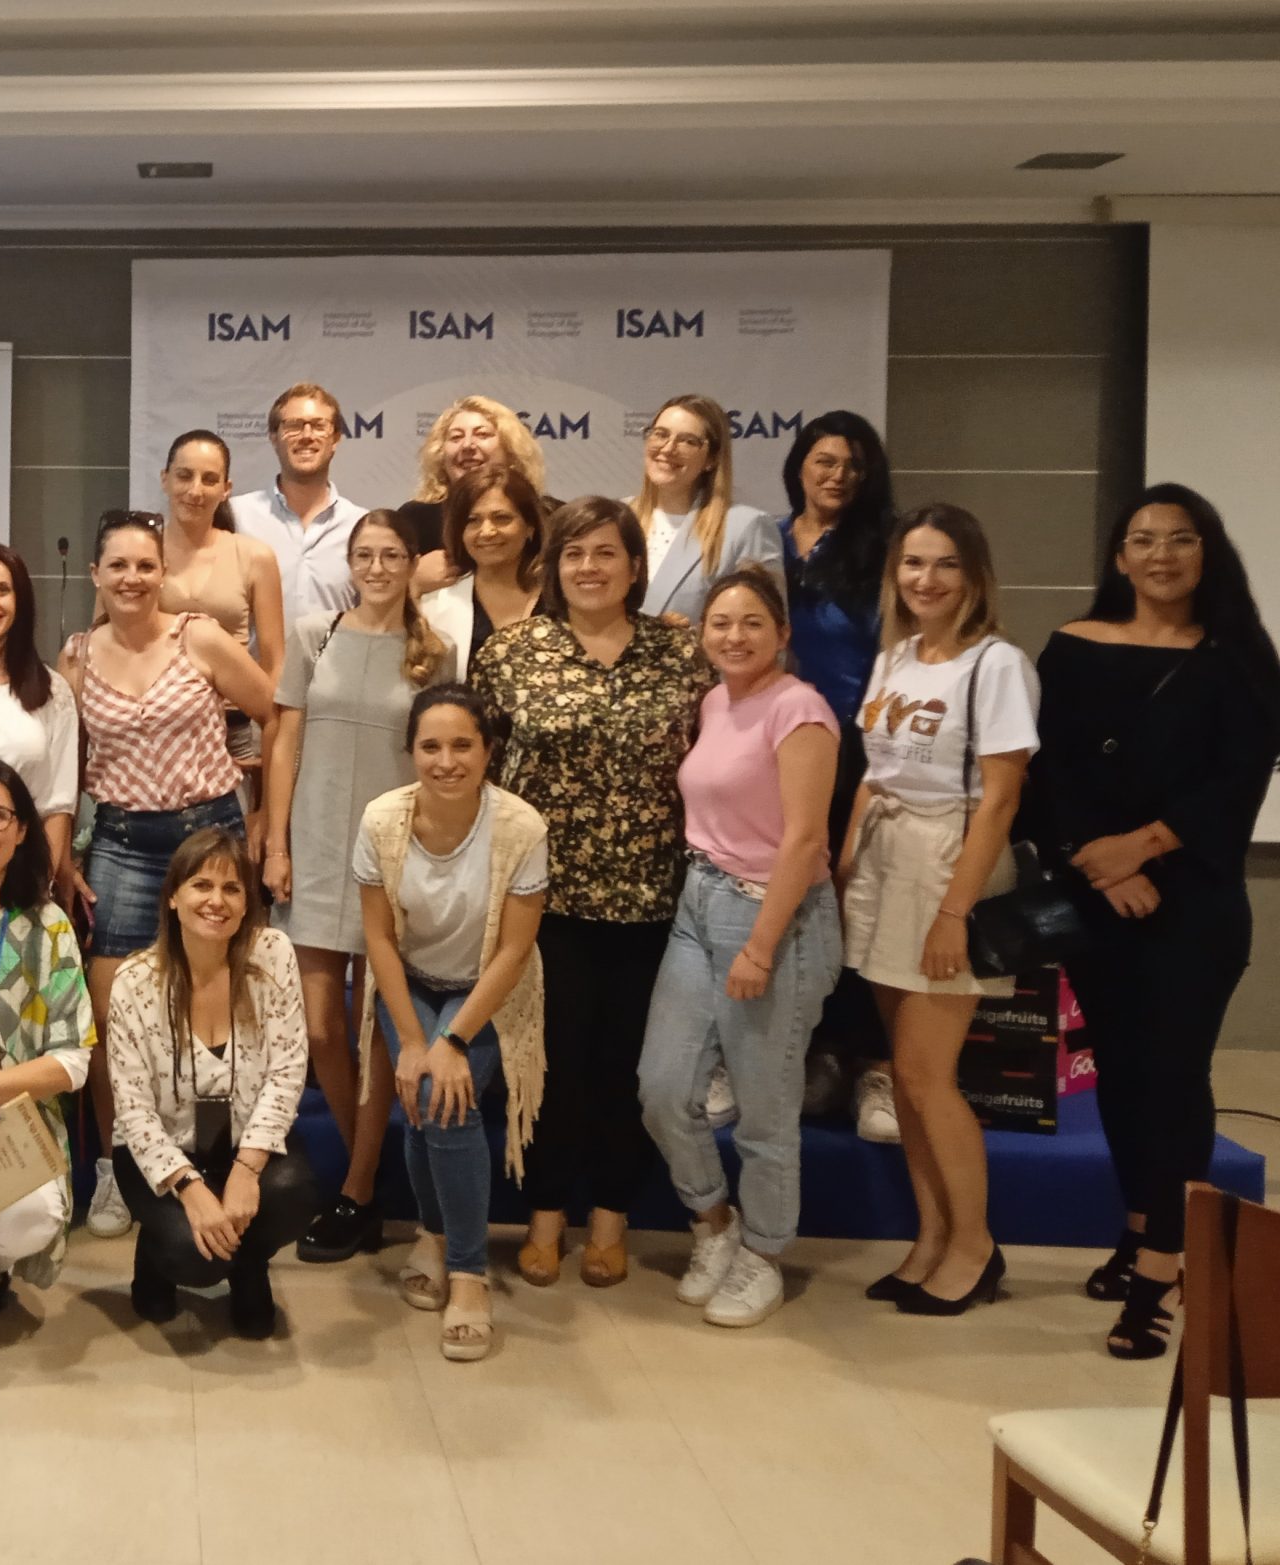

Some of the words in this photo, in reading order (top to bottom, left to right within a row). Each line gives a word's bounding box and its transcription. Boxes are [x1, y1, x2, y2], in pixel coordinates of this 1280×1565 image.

[208, 313, 291, 341] ISAM
[409, 310, 494, 340] ISAM
[616, 308, 704, 338] ISAM
[515, 410, 591, 439] SAM
[726, 410, 804, 439] SAM
